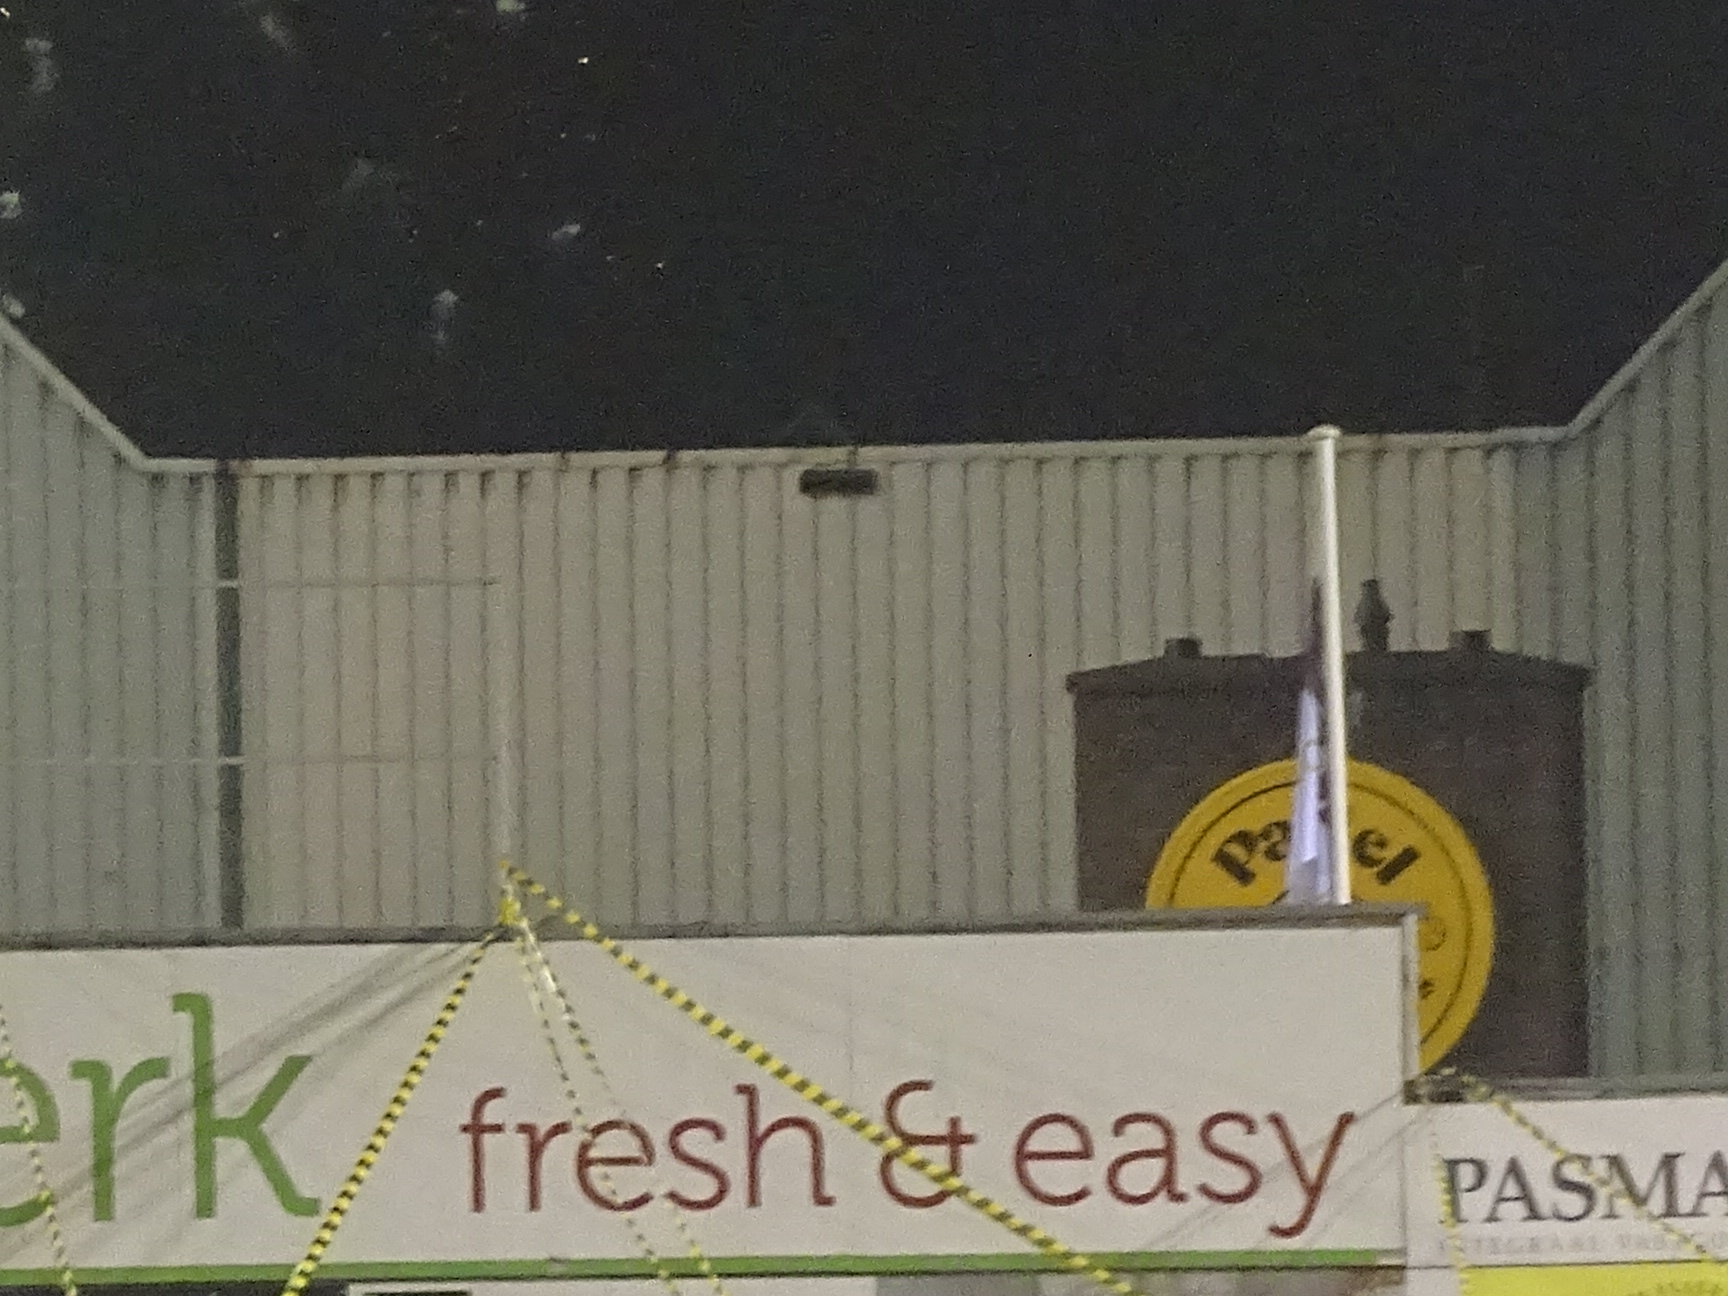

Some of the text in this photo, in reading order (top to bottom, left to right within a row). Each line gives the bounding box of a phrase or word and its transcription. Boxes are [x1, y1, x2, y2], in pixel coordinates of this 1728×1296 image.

[1210, 820, 1422, 888] Pael
[461, 1079, 1356, 1239] fresh & easy
